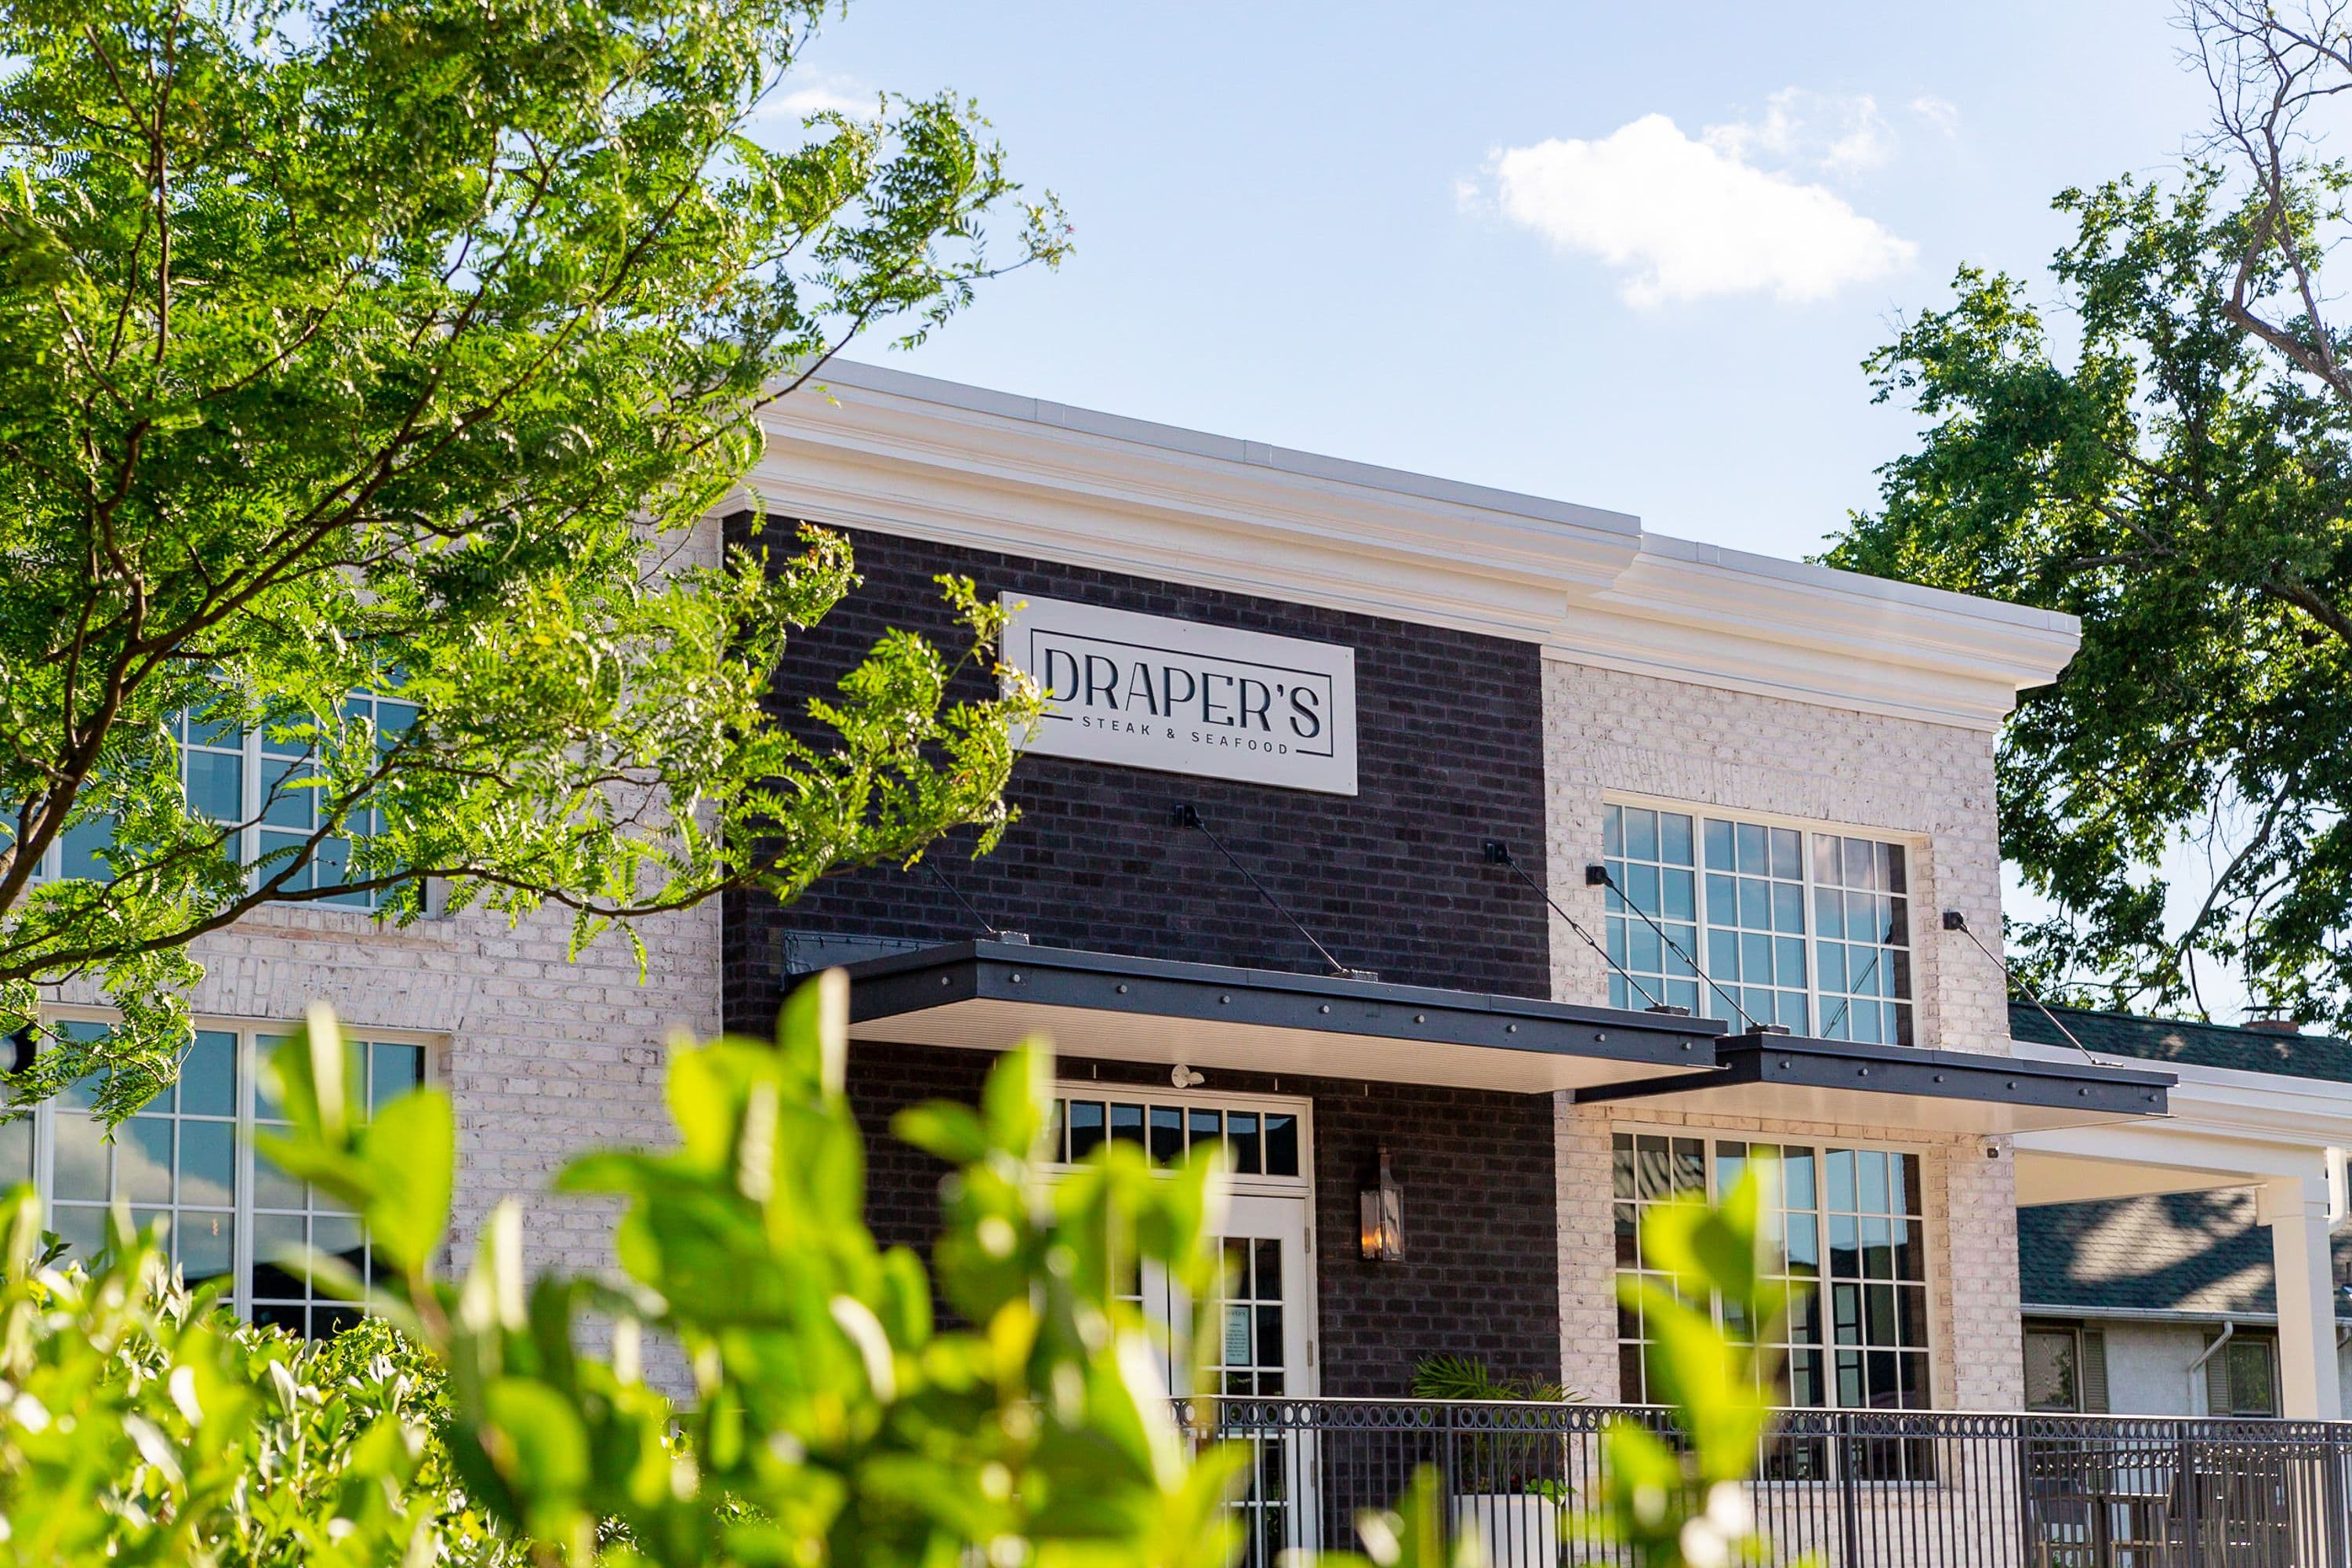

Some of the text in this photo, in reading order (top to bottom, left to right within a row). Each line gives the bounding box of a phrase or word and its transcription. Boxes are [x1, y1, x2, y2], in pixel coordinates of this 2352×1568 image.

[1045, 648, 1321, 739] DRAPER'S
[1082, 716, 1287, 754] STEAK & SEAFOOD
